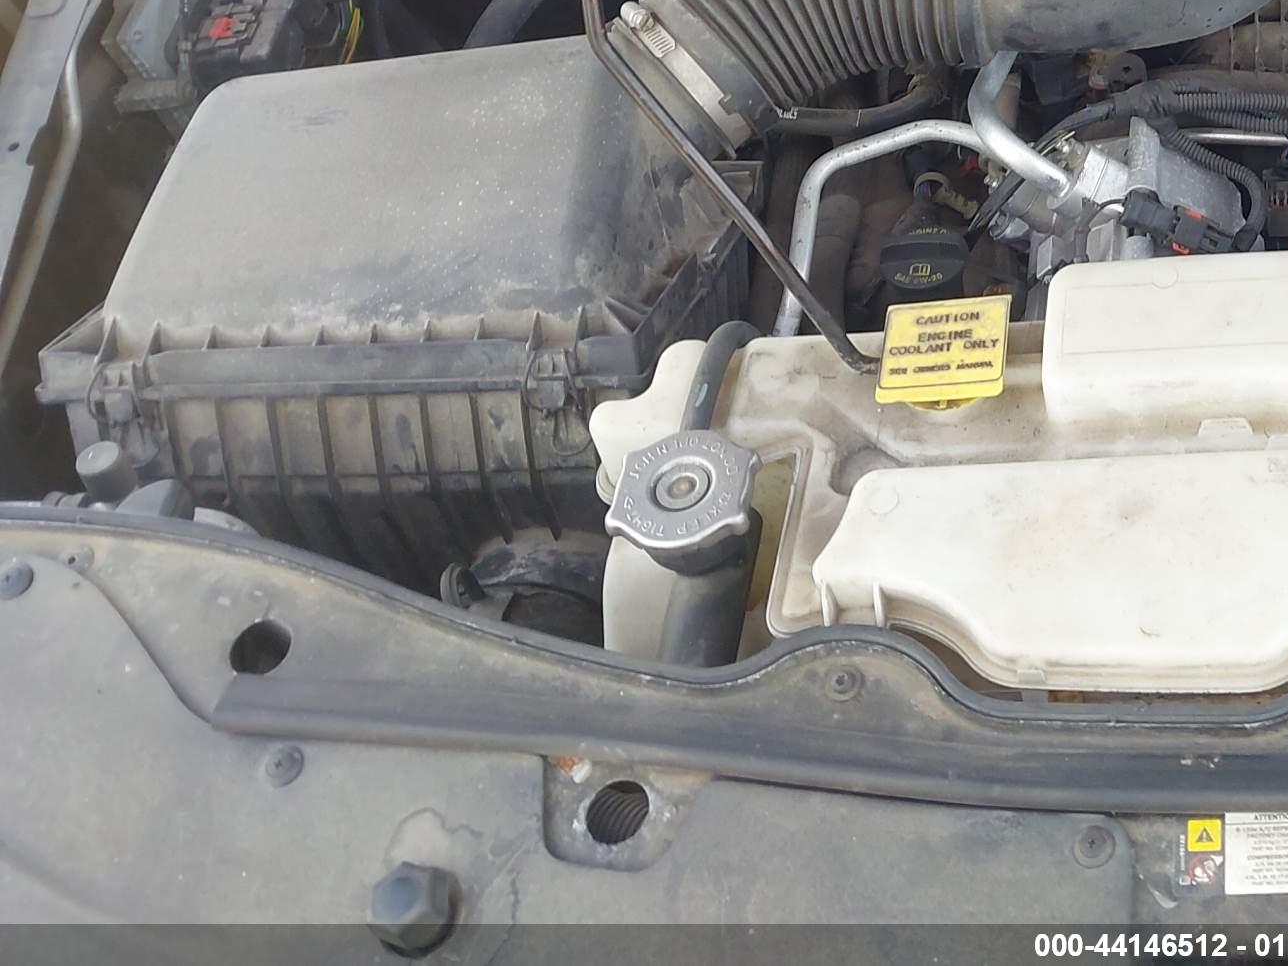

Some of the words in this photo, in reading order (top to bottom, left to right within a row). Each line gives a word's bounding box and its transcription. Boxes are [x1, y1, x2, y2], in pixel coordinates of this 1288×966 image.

[916, 312, 980, 325] CAUTION
[918, 329, 973, 342] ENGINE
[889, 342, 952, 356] COOLANT
[963, 338, 999, 350] ONLY
